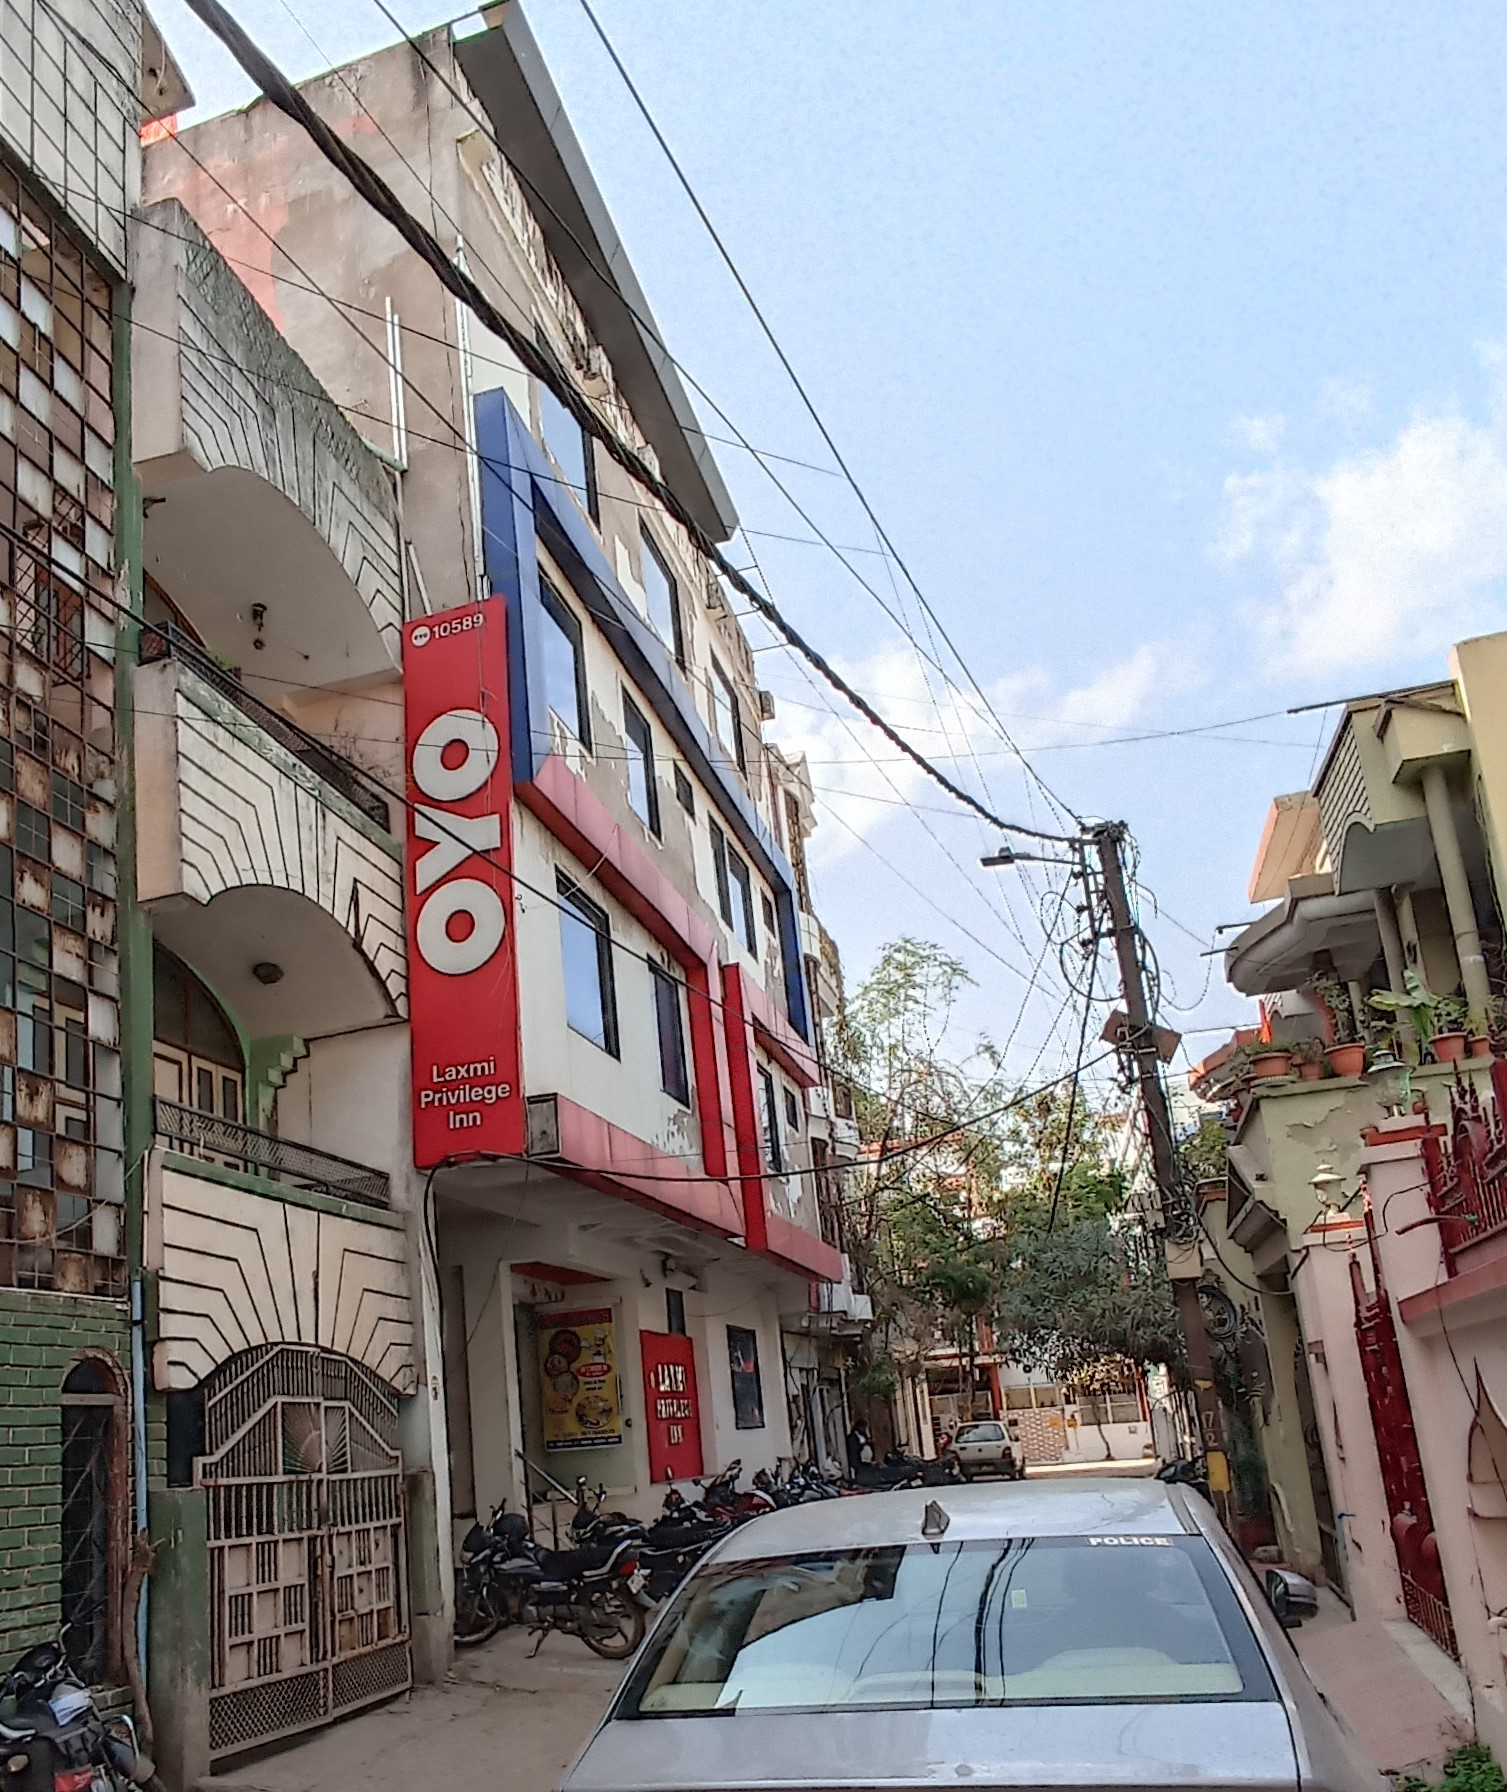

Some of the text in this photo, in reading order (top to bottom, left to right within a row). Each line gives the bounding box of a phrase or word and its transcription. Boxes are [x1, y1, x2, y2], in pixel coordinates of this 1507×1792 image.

[432, 613, 484, 639] 10589
[412, 708, 507, 975] OYO
[432, 1056, 495, 1082] Laxmi
[420, 1083, 511, 1109] Privilege
[449, 1110, 481, 1129] Inn
[1088, 1536, 1170, 1546] POLICE
